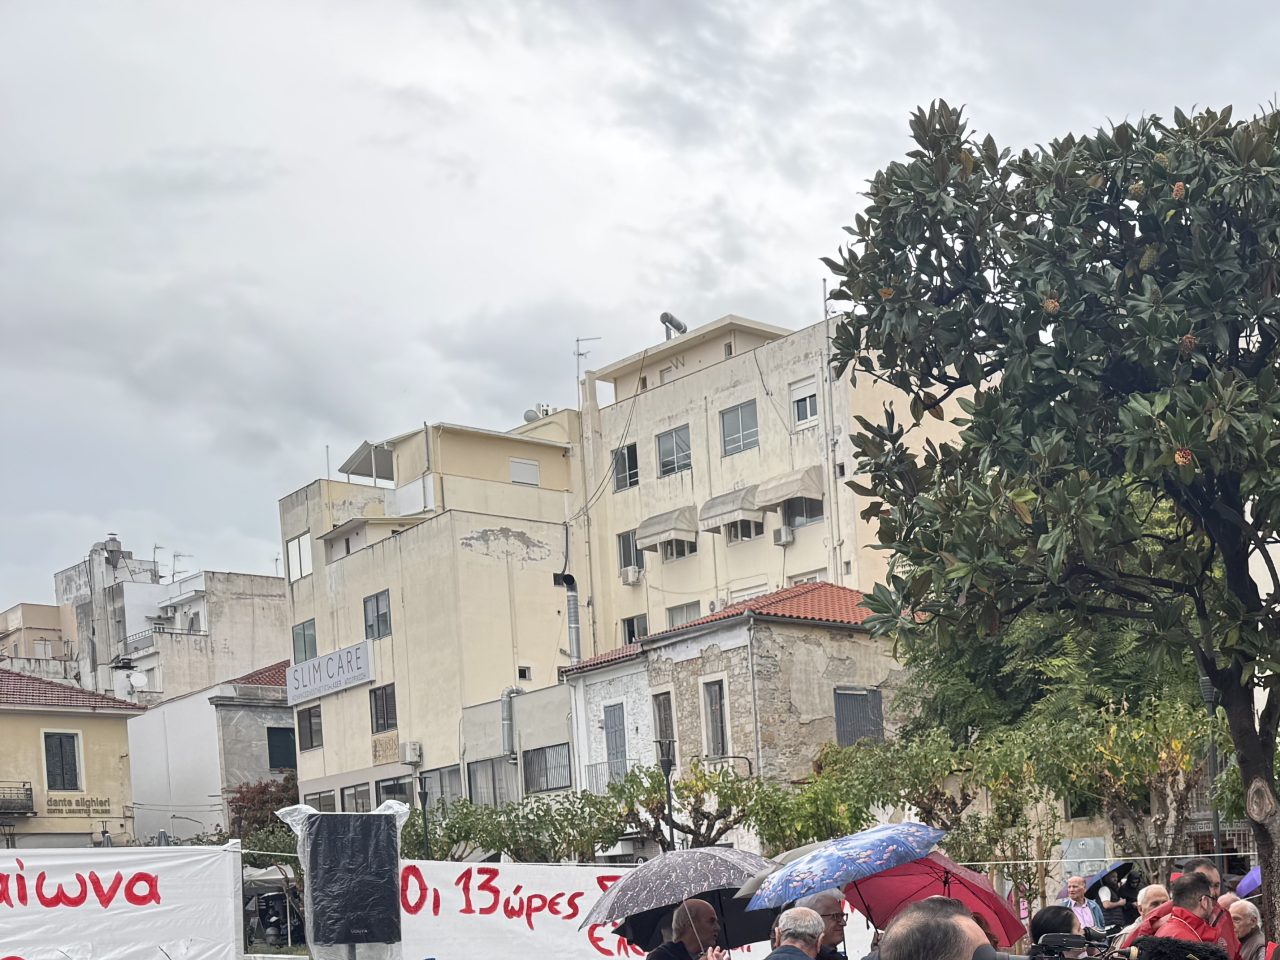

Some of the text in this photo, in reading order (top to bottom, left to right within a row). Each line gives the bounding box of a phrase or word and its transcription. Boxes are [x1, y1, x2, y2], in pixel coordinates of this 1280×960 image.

[293, 647, 362, 690] SLIM CARE
[47, 797, 110, 809] dante alighieri
[400, 864, 441, 916] Οι
